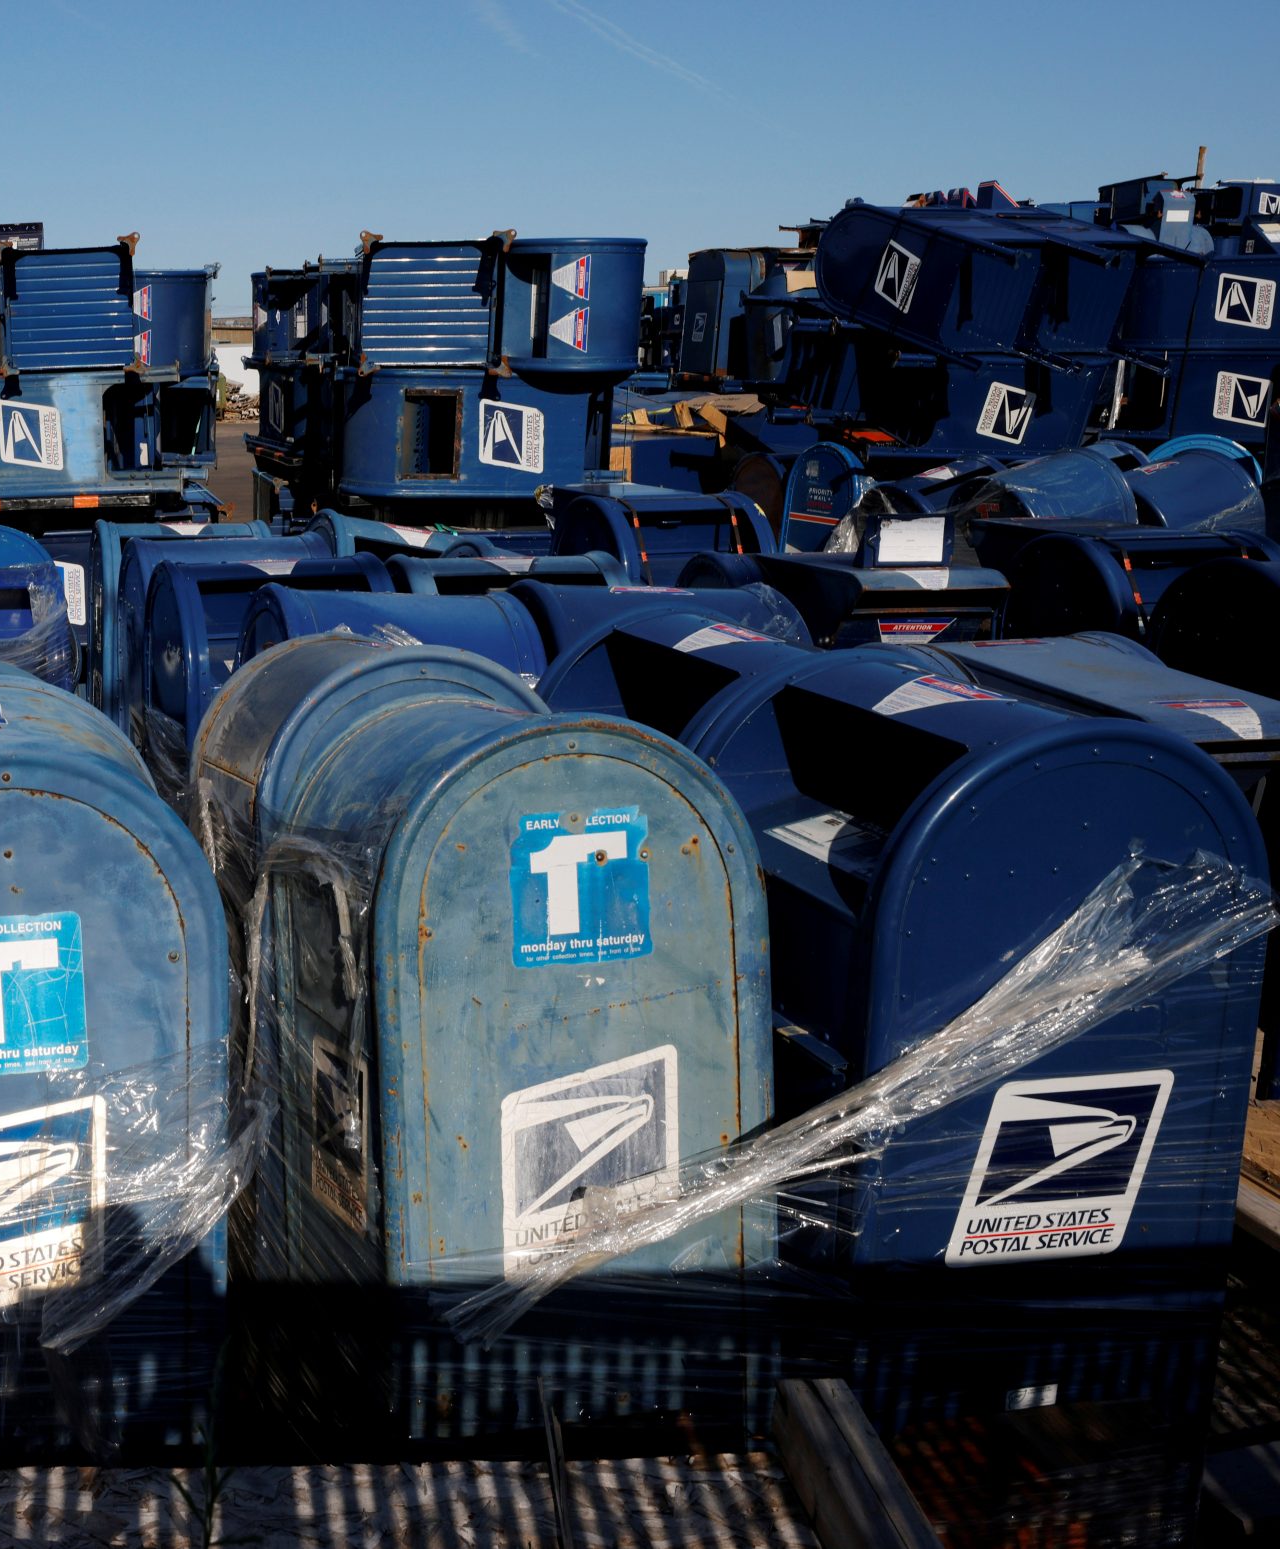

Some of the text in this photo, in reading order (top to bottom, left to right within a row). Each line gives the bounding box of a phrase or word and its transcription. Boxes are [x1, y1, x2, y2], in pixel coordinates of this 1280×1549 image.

[808, 487, 833, 496] PRIORITY
[526, 814, 630, 830] EARLY LECTION
[521, 933, 645, 953] monday thru saturday
[23, 1044, 79, 1057] saturday
[515, 1214, 589, 1247] UNITED
[966, 1208, 1111, 1235] UNITED STATES
[9, 1237, 84, 1268] STATES
[959, 1228, 1114, 1256] POSTAL SERVICE
